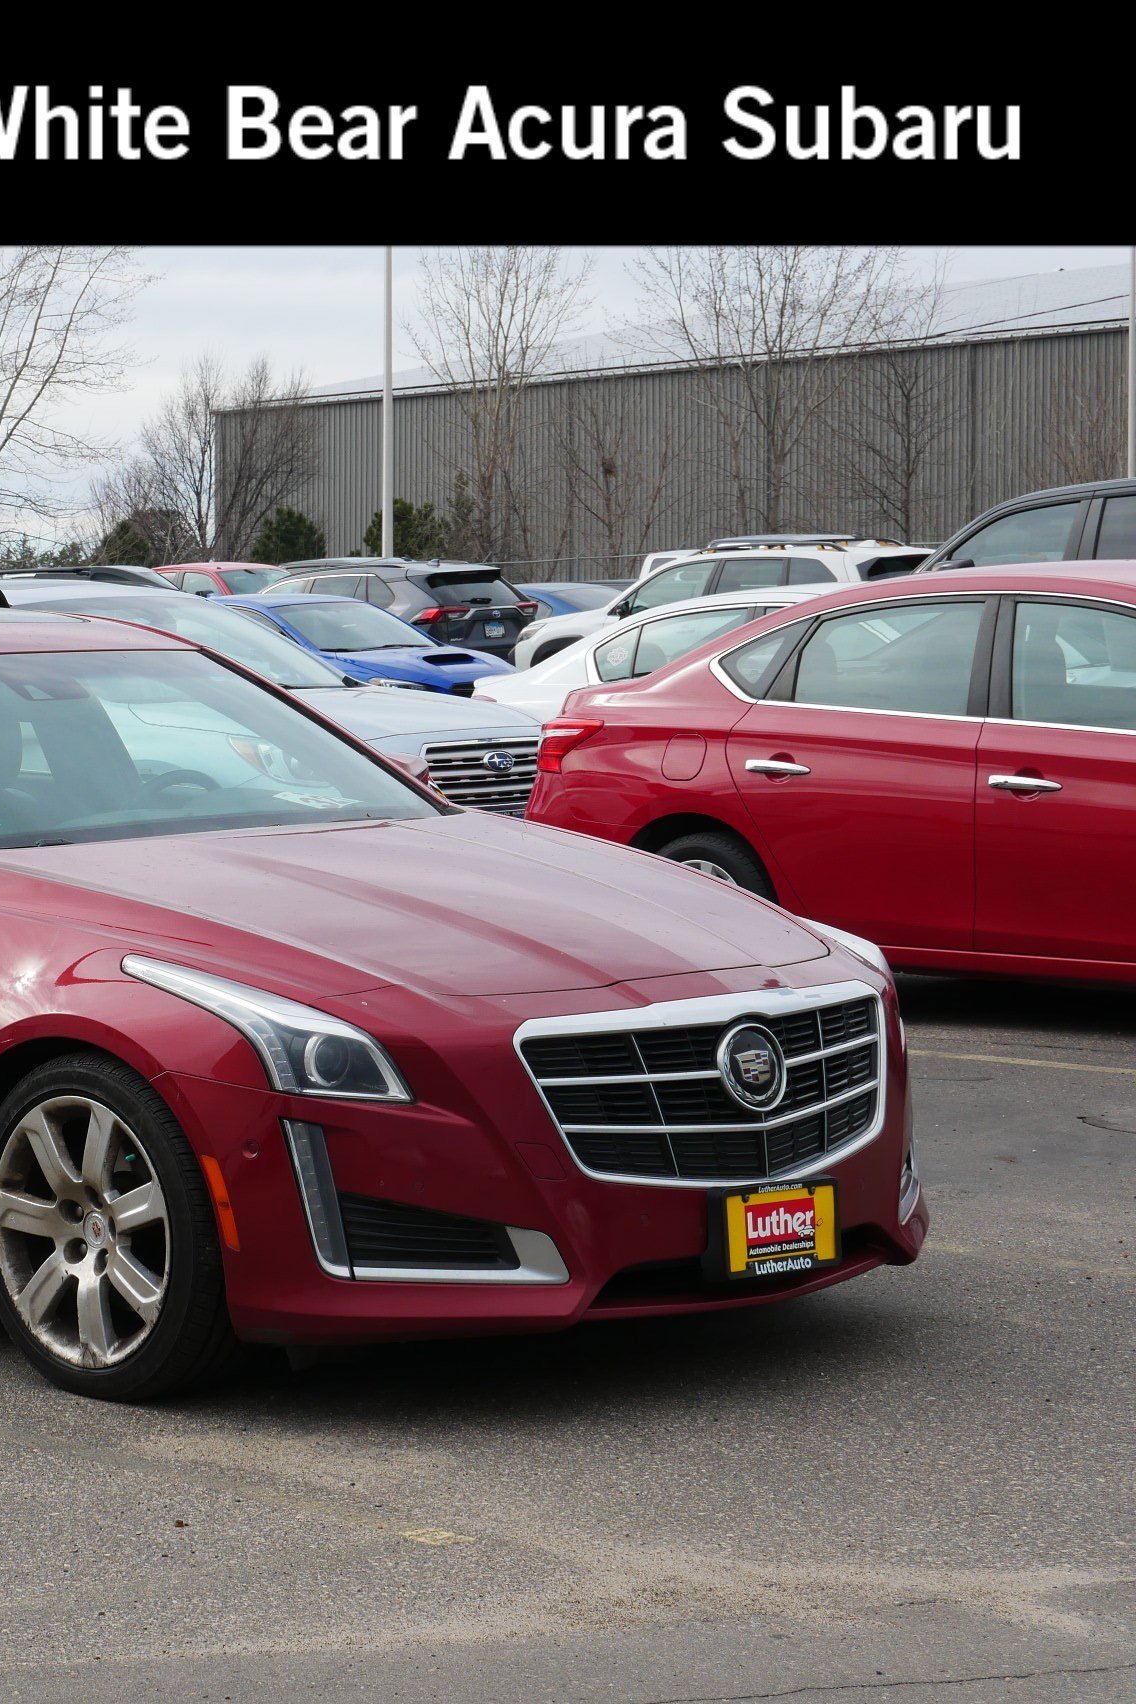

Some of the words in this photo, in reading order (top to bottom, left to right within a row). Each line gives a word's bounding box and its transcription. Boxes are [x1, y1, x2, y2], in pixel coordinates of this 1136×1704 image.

[758, 1183, 803, 1194] LutherAuto.com
[746, 1207, 814, 1239] Luther
[749, 1244, 782, 1256] Automobile
[782, 1240, 814, 1252] Dealerships
[754, 1257, 812, 1275] LutherAuto
